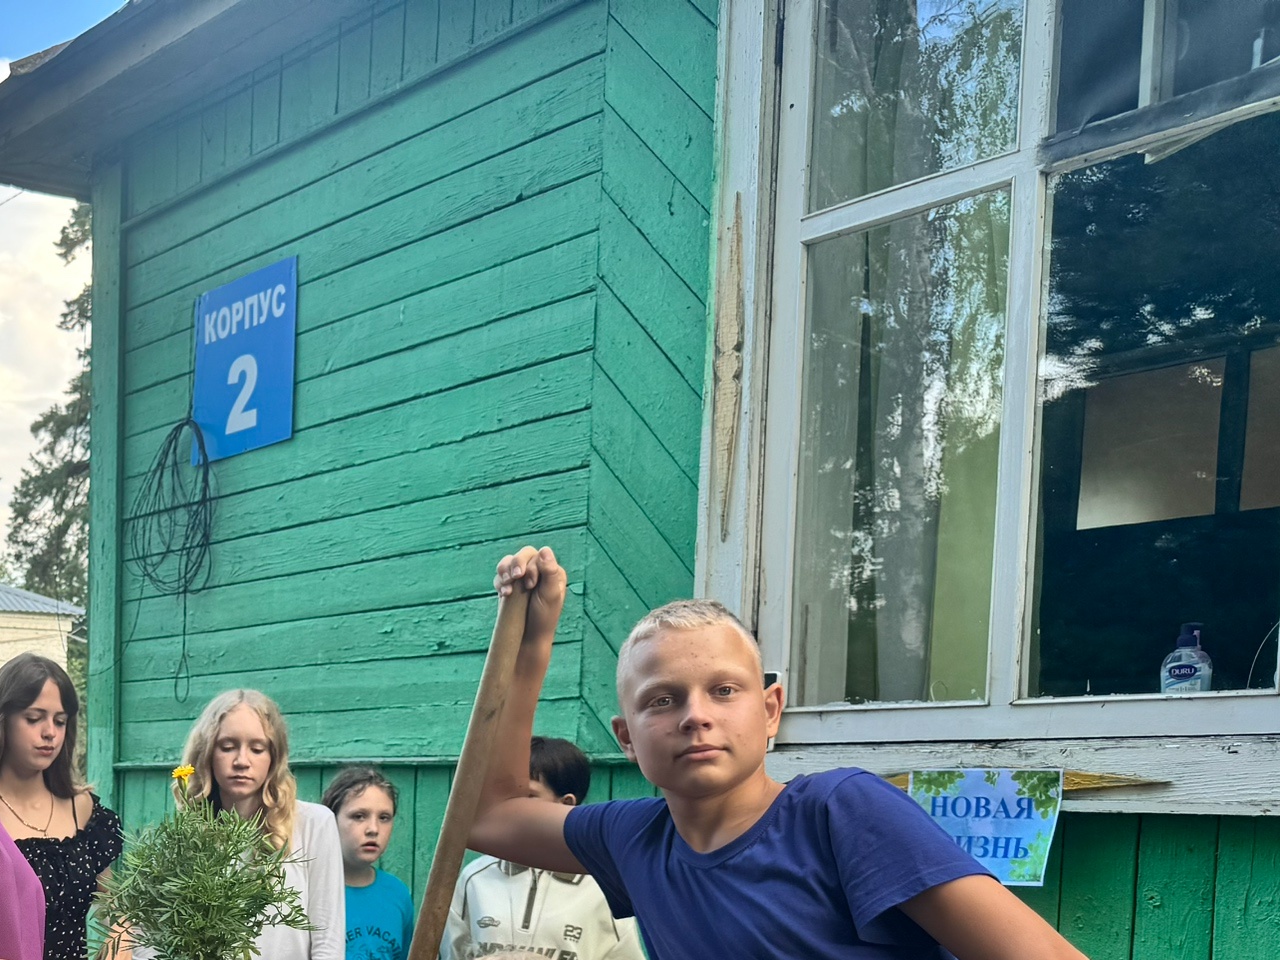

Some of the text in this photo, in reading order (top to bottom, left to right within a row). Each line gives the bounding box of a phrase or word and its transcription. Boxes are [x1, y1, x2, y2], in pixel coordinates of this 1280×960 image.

[204, 283, 287, 345] КОРПУС
[225, 353, 258, 435] 2
[1171, 667, 1195, 676] DURU
[930, 796, 1034, 820] НОВАЯ
[953, 835, 1029, 859] ИЗНЬ
[345, 927, 362, 944] ER
[563, 924, 583, 941] 23
